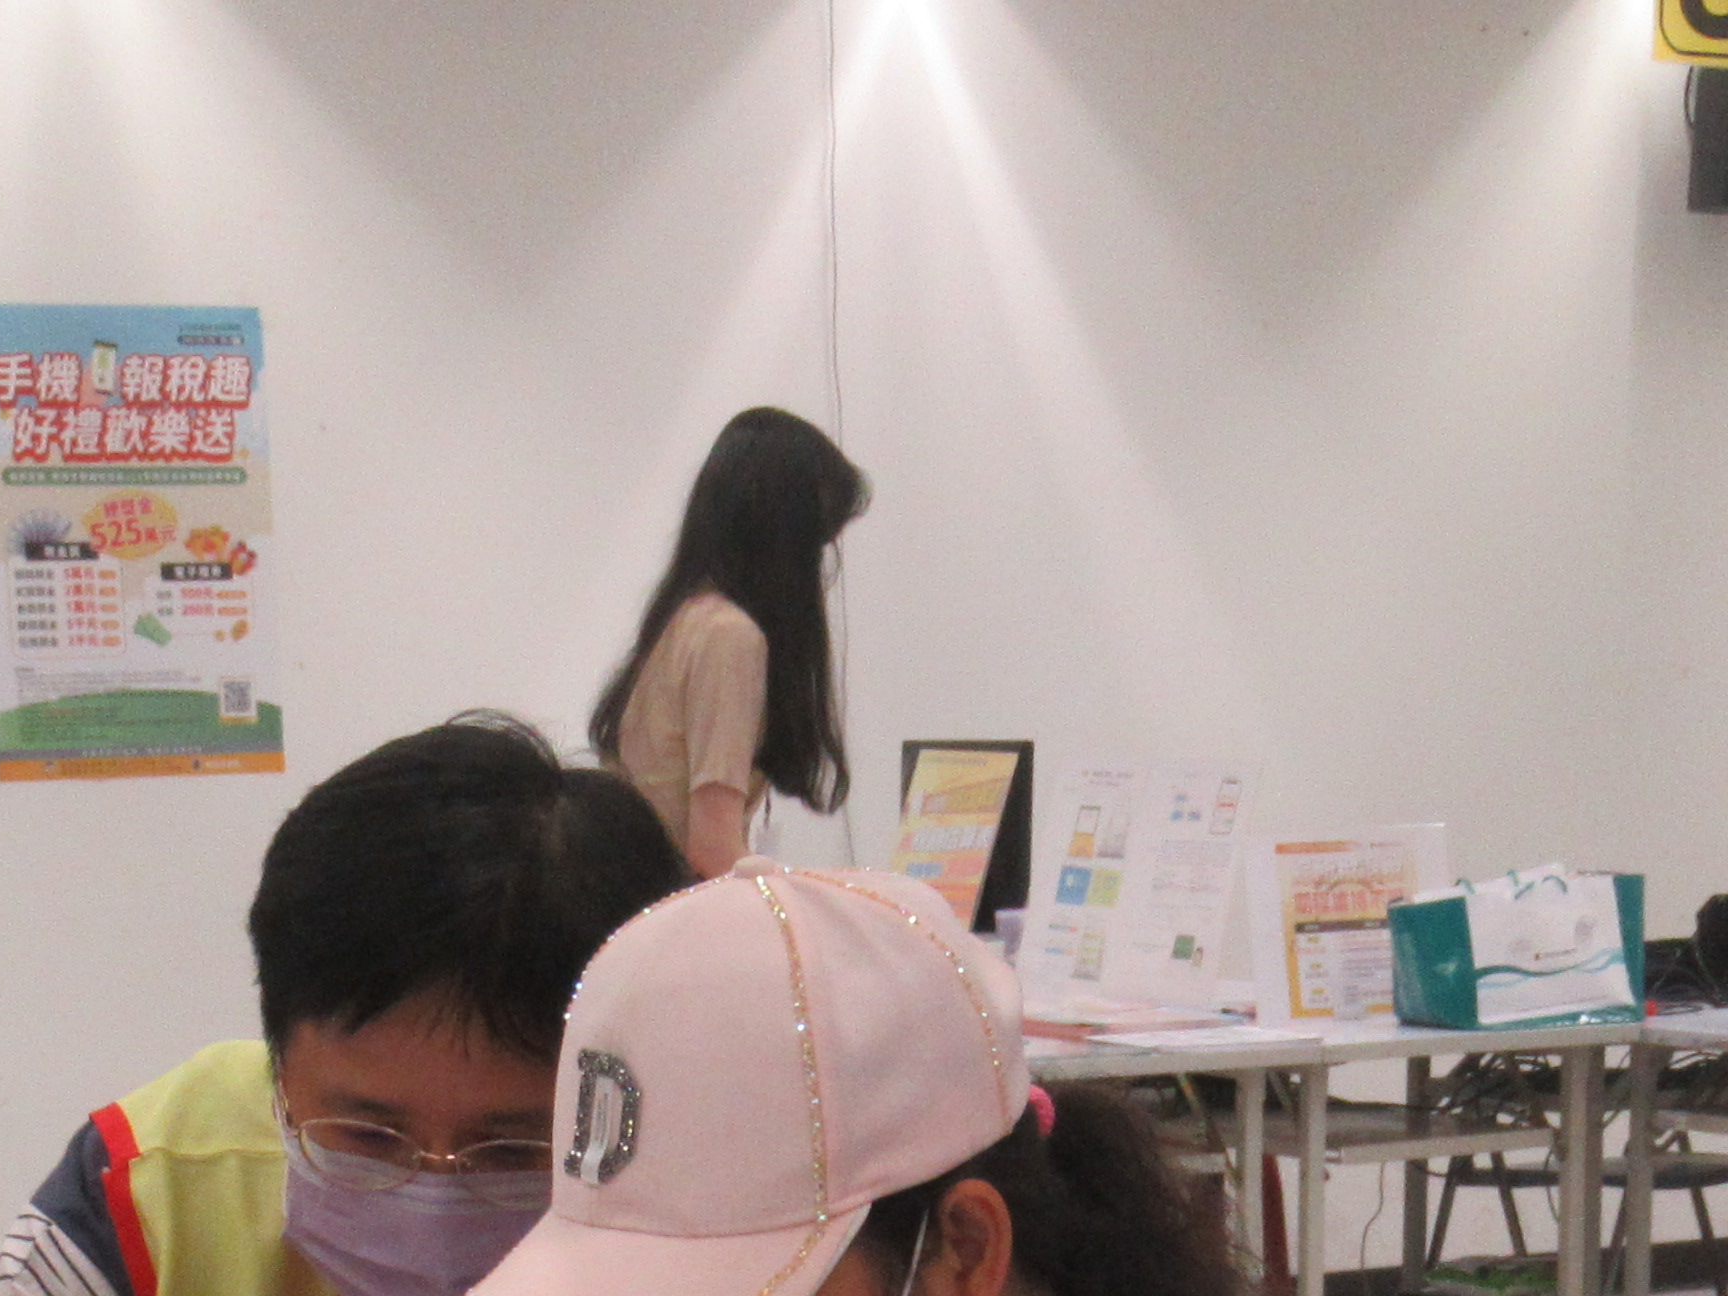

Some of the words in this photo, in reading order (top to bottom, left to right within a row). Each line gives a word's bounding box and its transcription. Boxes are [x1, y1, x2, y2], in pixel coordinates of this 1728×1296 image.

[122, 353, 252, 407] 報稅趣
[13, 406, 236, 462] 好禮歡樂送
[87, 518, 178, 550] 525萬元
[563, 1047, 643, 1185] D
